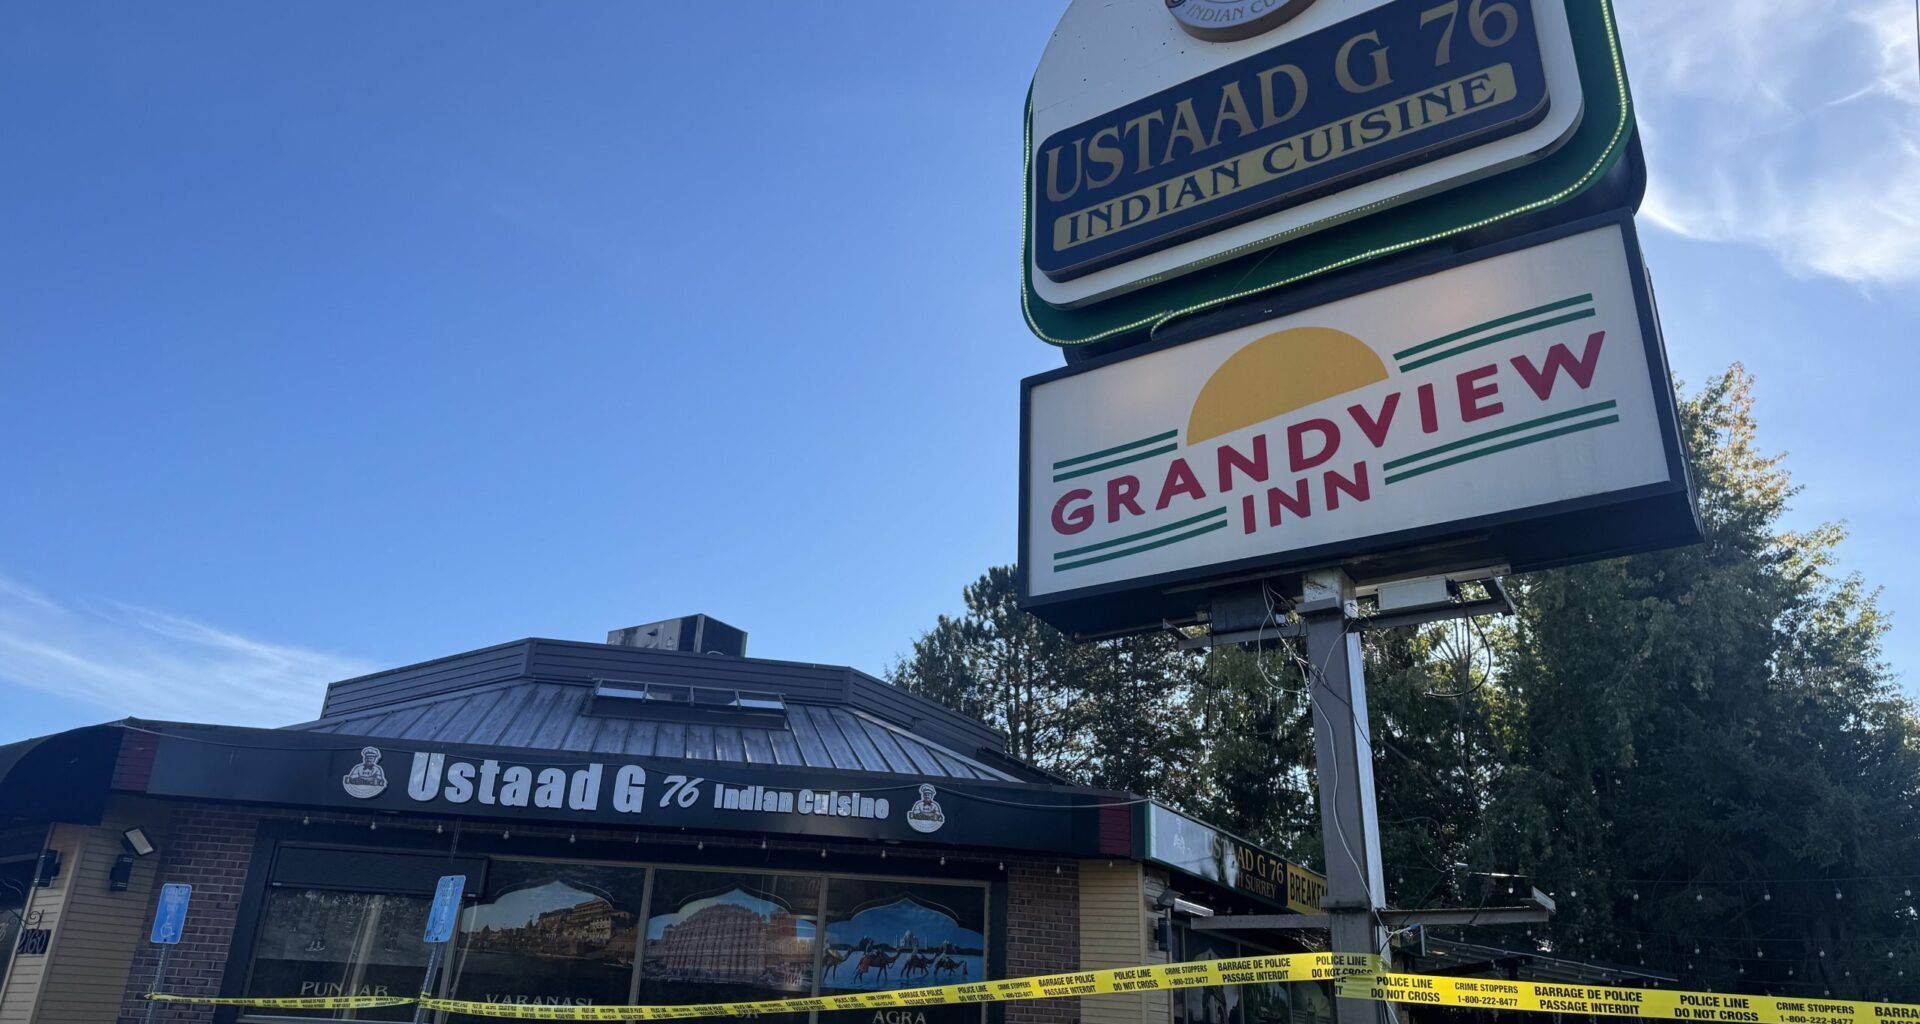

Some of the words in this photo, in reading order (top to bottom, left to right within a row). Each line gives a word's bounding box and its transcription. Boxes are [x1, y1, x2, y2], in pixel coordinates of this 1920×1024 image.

[1186, 4, 1244, 22] INDIAN
[1045, 63, 1308, 202] USTAAD
[1335, 30, 1393, 93] G
[1419, 0, 1519, 67] 76
[1068, 159, 1245, 245] INDIAN
[1263, 73, 1499, 174] CUISINE
[1051, 331, 1605, 535] GRANDVIEW
[1243, 461, 1371, 535] INN
[407, 752, 603, 811] Ustaad
[612, 764, 646, 814] G
[659, 774, 705, 809] 76
[714, 783, 794, 814] Indian
[798, 788, 890, 820] Cuisine
[1257, 854, 1266, 878] G
[1269, 859, 1284, 884] 76
[1245, 874, 1276, 899] SURREY
[1290, 872, 1328, 912] BREAKF
[1218, 961, 1251, 971] BARRAGE
[1253, 960, 1263, 969] DE
[1265, 958, 1291, 968] POLICE
[1316, 956, 1345, 966] POLICE
[1347, 956, 1367, 966] LINE
[1114, 971, 1136, 980] POLICE
[1137, 969, 1152, 978] LINE
[1165, 967, 1180, 975] CRIME
[1181, 965, 1207, 974] STOPPERS
[1222, 972, 1255, 983] PASSAGE
[1257, 970, 1290, 980] INTERDIT
[1312, 969, 1322, 978] DO
[1325, 968, 1341, 977] NOT
[1038, 977, 1064, 987] BARRAGE
[1065, 976, 1073, 985] DE
[1075, 974, 1095, 984] POLICE
[1112, 982, 1122, 991] DO
[1123, 981, 1136, 990] NOT
[1136, 979, 1158, 989] CROSS
[1376, 976, 1409, 988] POLICE
[1411, 978, 1433, 989] LINE
[300, 981, 388, 997] PUNJAB
[1043, 987, 1070, 996] PASSAGE
[1070, 985, 1096, 995] INTERDIT
[1371, 988, 1384, 998] DO
[1387, 989, 1405, 1000] NOT
[1408, 991, 1440, 1002] CROSS
[1455, 982, 1478, 993] CRIME
[1480, 983, 1519, 994] STOPPERS
[1534, 986, 1584, 999] BARRAGE
[1587, 989, 1601, 1000] DE
[1604, 990, 1643, 1002] POLICE
[486, 994, 593, 1006] VARANASI
[1457, 995, 1518, 1007] 1-800-222-8477
[1680, 995, 1721, 1007] POLICE
[1723, 997, 1750, 1009] LINE
[1539, 1000, 1589, 1013] PASSAGE
[1590, 1002, 1640, 1015] INTERDIT
[1776, 1002, 1805, 1012] CRIME
[1808, 1003, 1855, 1015] STOPPERS
[1874, 1006, 1920, 1019] BARRA
[872, 1010, 926, 1024] AGRA
[1674, 1008, 1690, 1018] DO
[1693, 1008, 1716, 1020] NOT
[1719, 1010, 1759, 1022] CROSS
